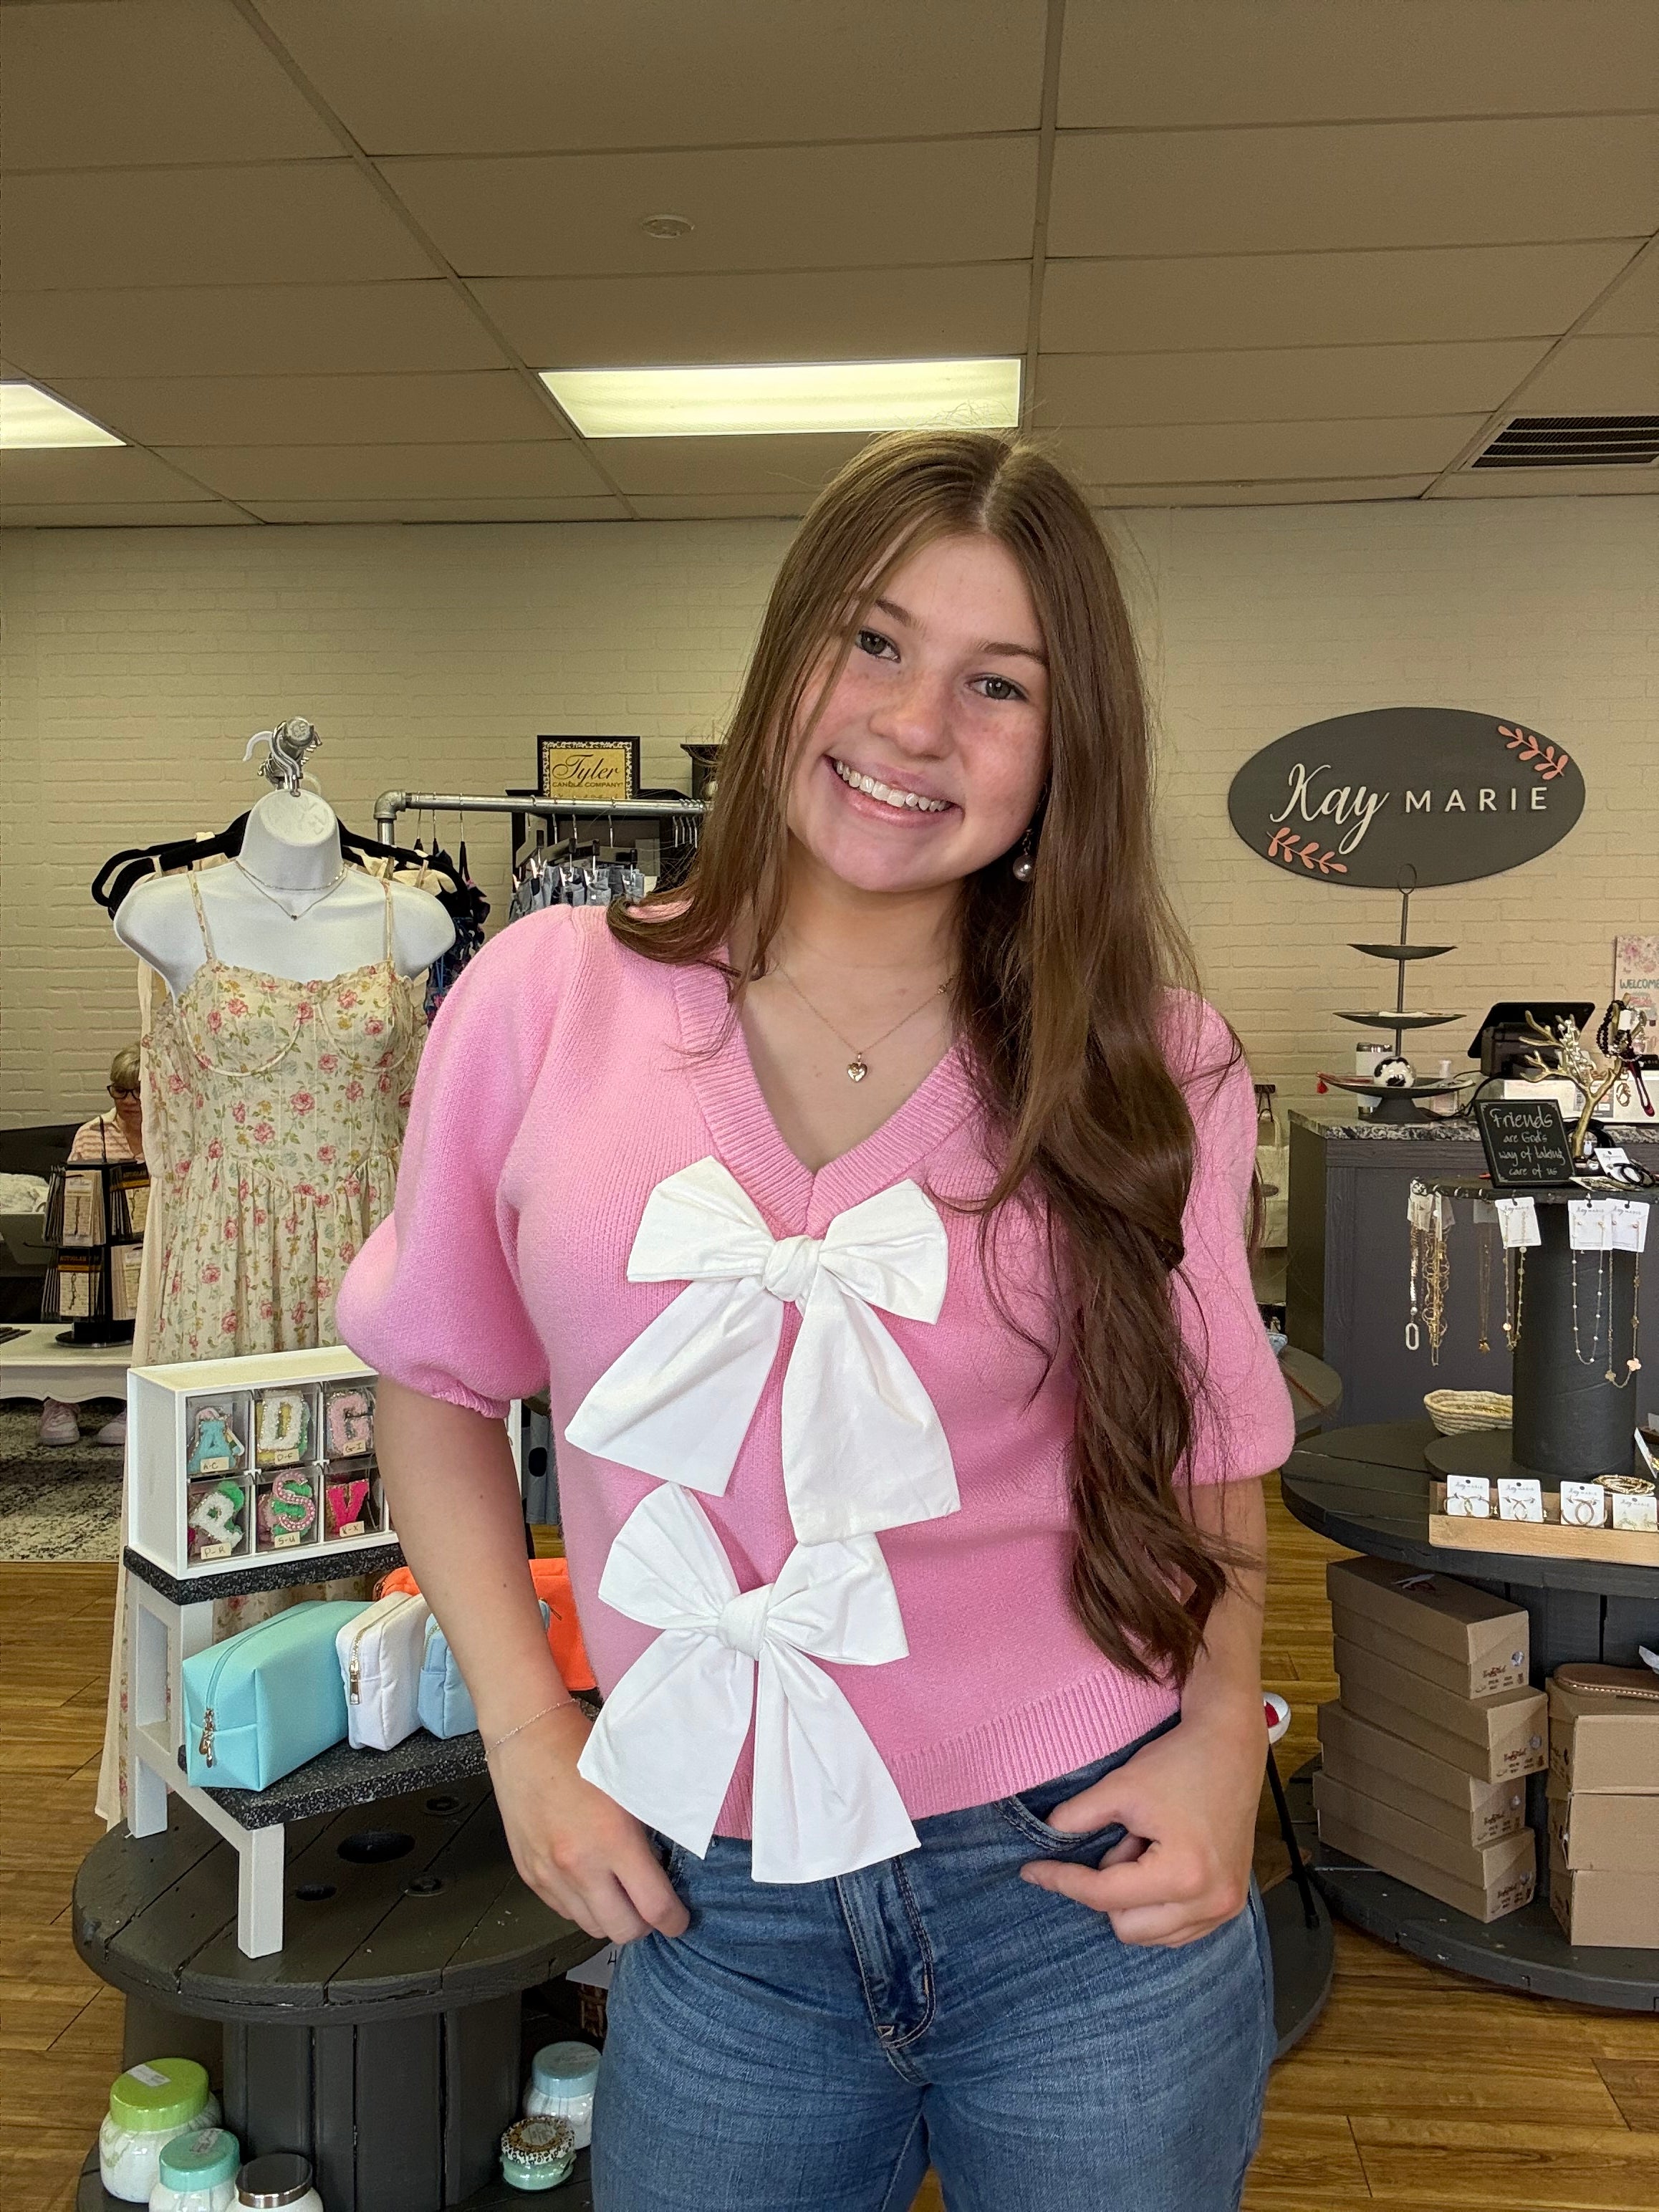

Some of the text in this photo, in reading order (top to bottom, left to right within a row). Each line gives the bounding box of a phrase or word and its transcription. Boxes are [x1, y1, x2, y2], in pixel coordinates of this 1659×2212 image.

[552, 754, 620, 787] Tyler
[1269, 763, 1548, 855] Kay MARIE
[1489, 1105, 1554, 1129] Friends
[1503, 1134, 1519, 1143] are
[1499, 1150, 1518, 1167] way
[1520, 1145, 1532, 1163] of
[1531, 1163, 1542, 1178] of
